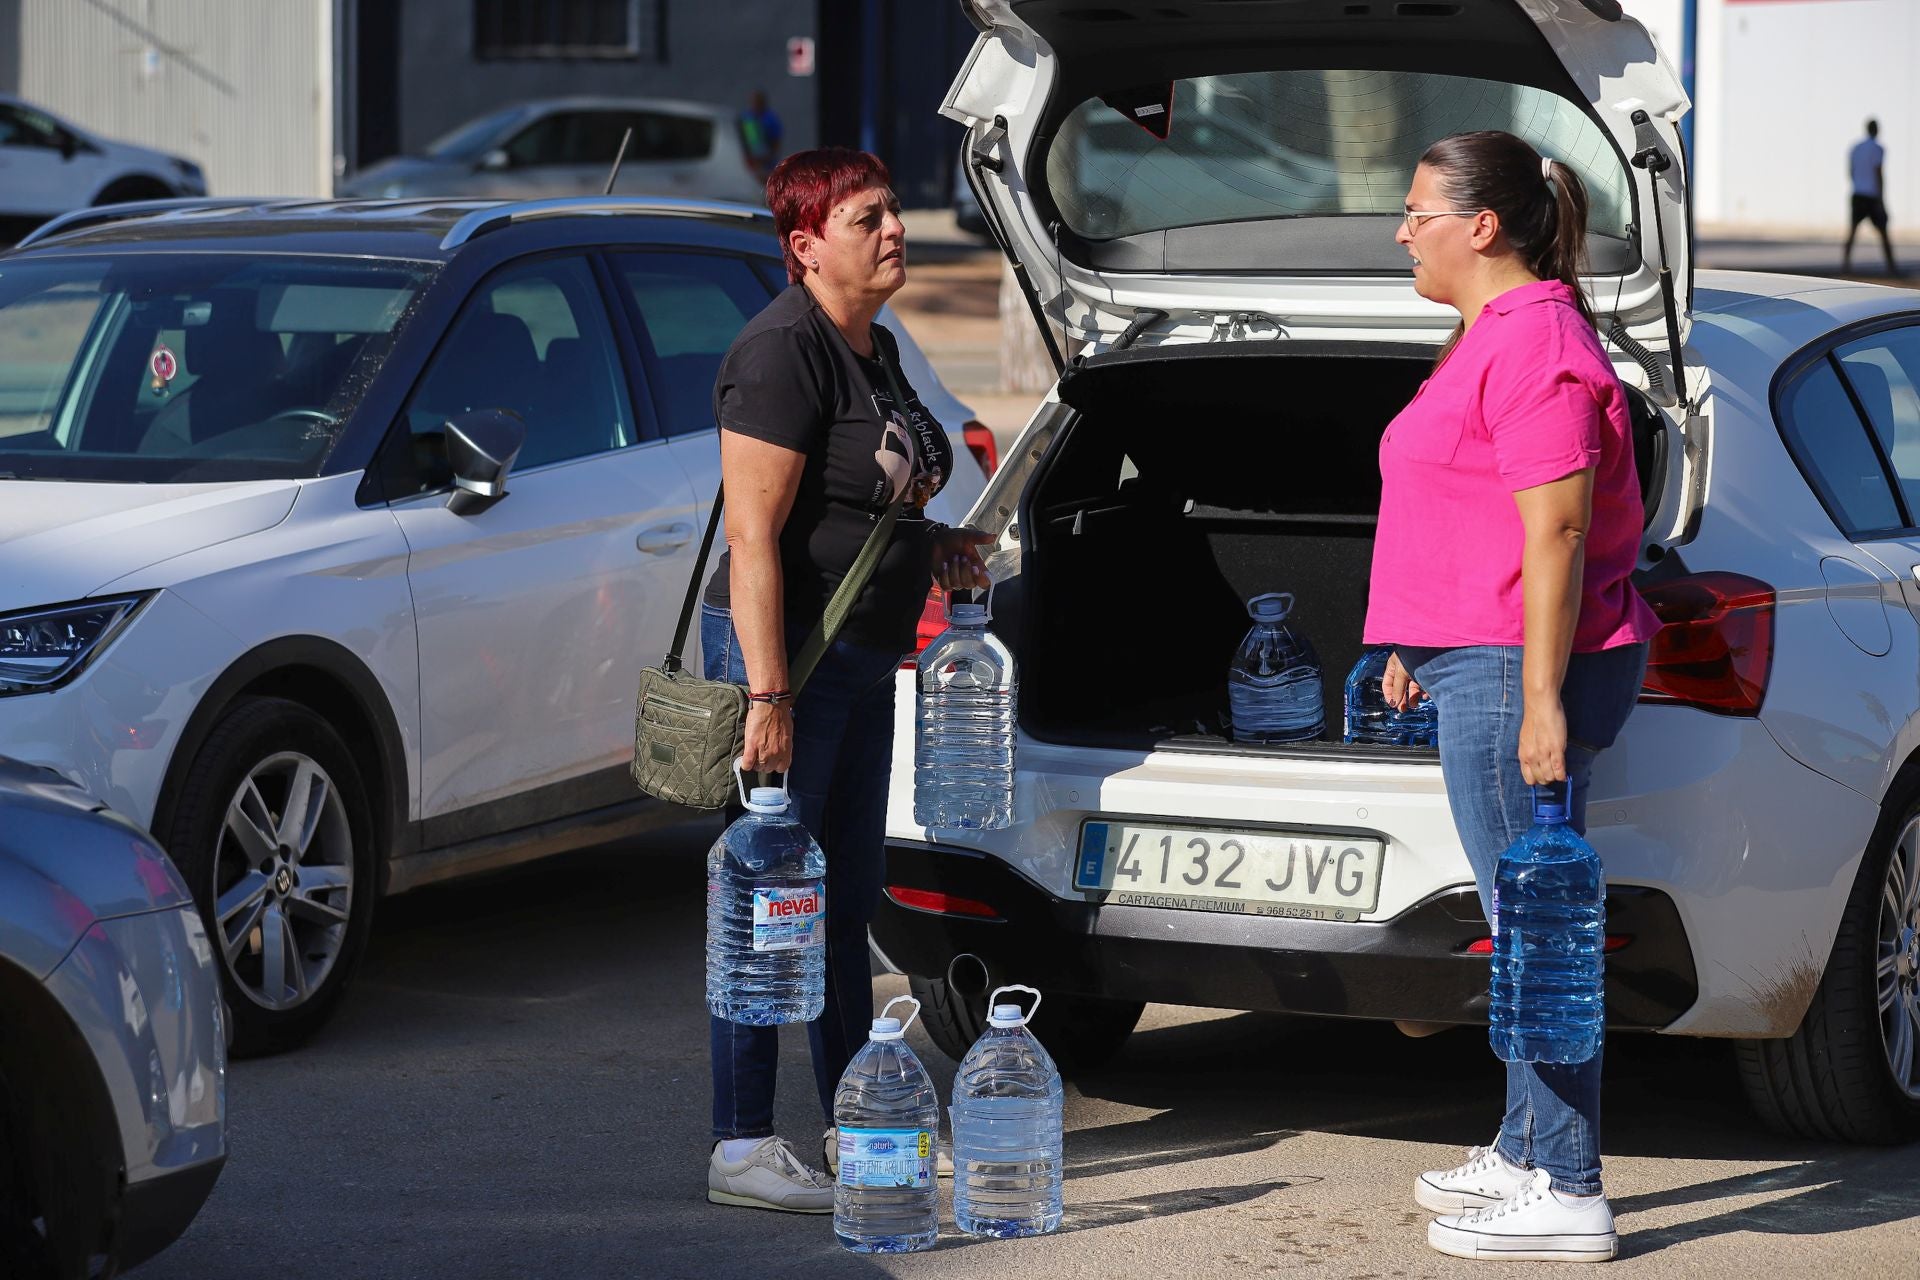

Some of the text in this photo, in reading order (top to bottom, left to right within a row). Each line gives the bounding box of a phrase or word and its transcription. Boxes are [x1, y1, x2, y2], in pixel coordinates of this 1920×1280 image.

[1085, 861, 1096, 874] E
[1116, 833, 1365, 897] 4132 JVG
[768, 892, 819, 917] neval
[1118, 894, 1246, 912] CARTAGENA PREMIUM
[1267, 906, 1284, 915] 968
[1300, 908, 1312, 917] 25
[1315, 910, 1325, 918] 11
